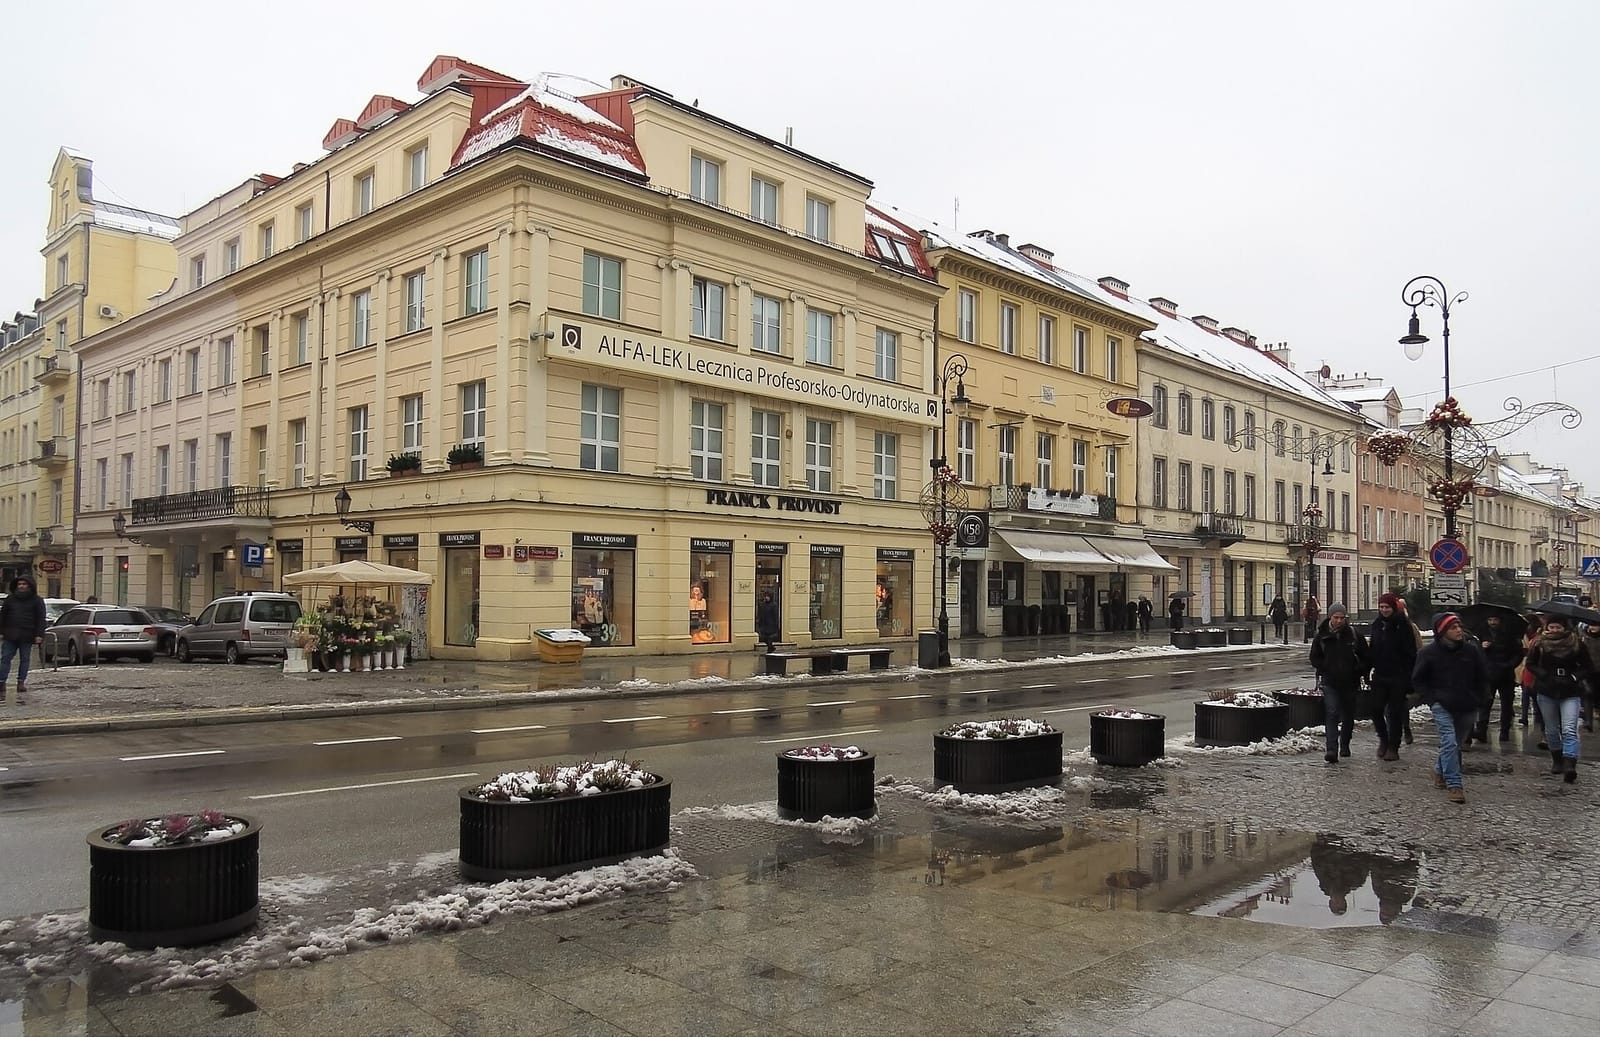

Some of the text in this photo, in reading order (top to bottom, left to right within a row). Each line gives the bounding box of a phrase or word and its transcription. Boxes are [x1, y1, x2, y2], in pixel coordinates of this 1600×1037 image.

[598, 335, 920, 415] ALFA-LEK Lecznica Profesorsko-Ordynatorska
[706, 489, 842, 515] FRANCK PROVOST
[711, 540, 730, 548] PROVOST
[248, 546, 261, 563] P
[597, 568, 609, 576] MEN
[601, 623, 617, 642] 39
[823, 619, 834, 635] 39
